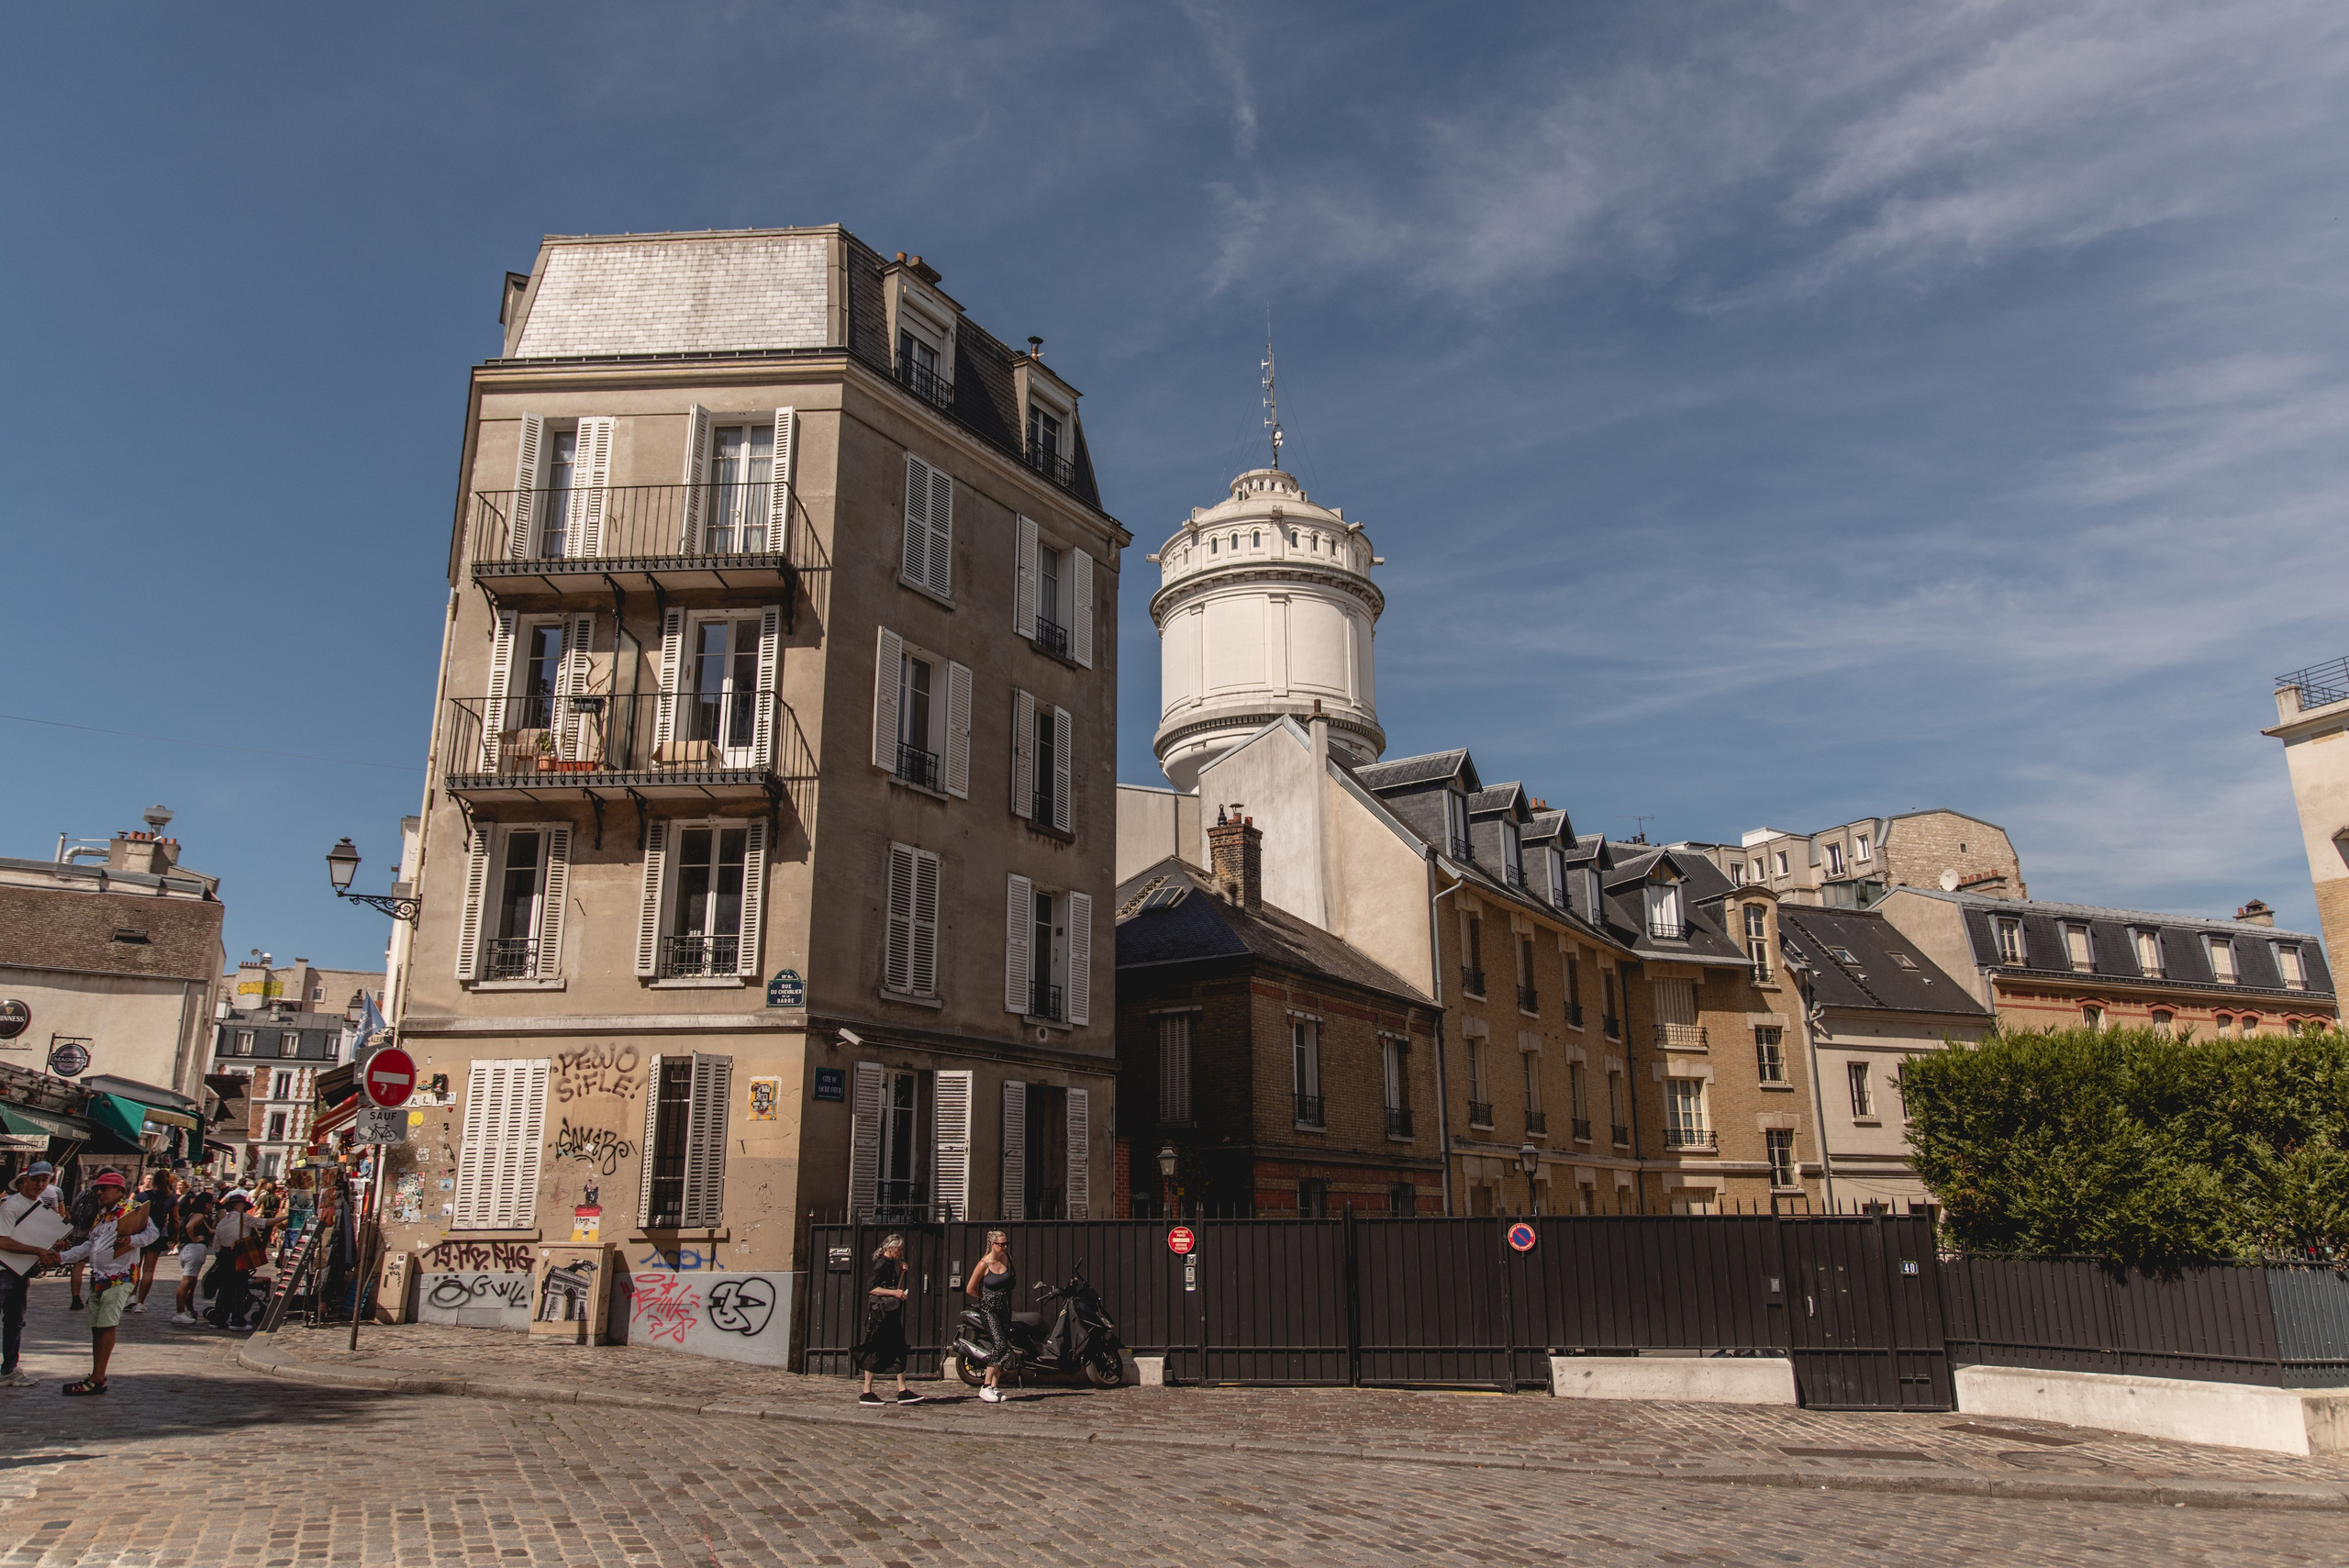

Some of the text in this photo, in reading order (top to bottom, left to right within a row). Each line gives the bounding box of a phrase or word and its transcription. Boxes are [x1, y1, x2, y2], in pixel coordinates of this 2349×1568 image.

[369, 1111, 397, 1120] SAUF
[302, 1237, 318, 1265] MUSIC
[1905, 1262, 1915, 1273] 40
